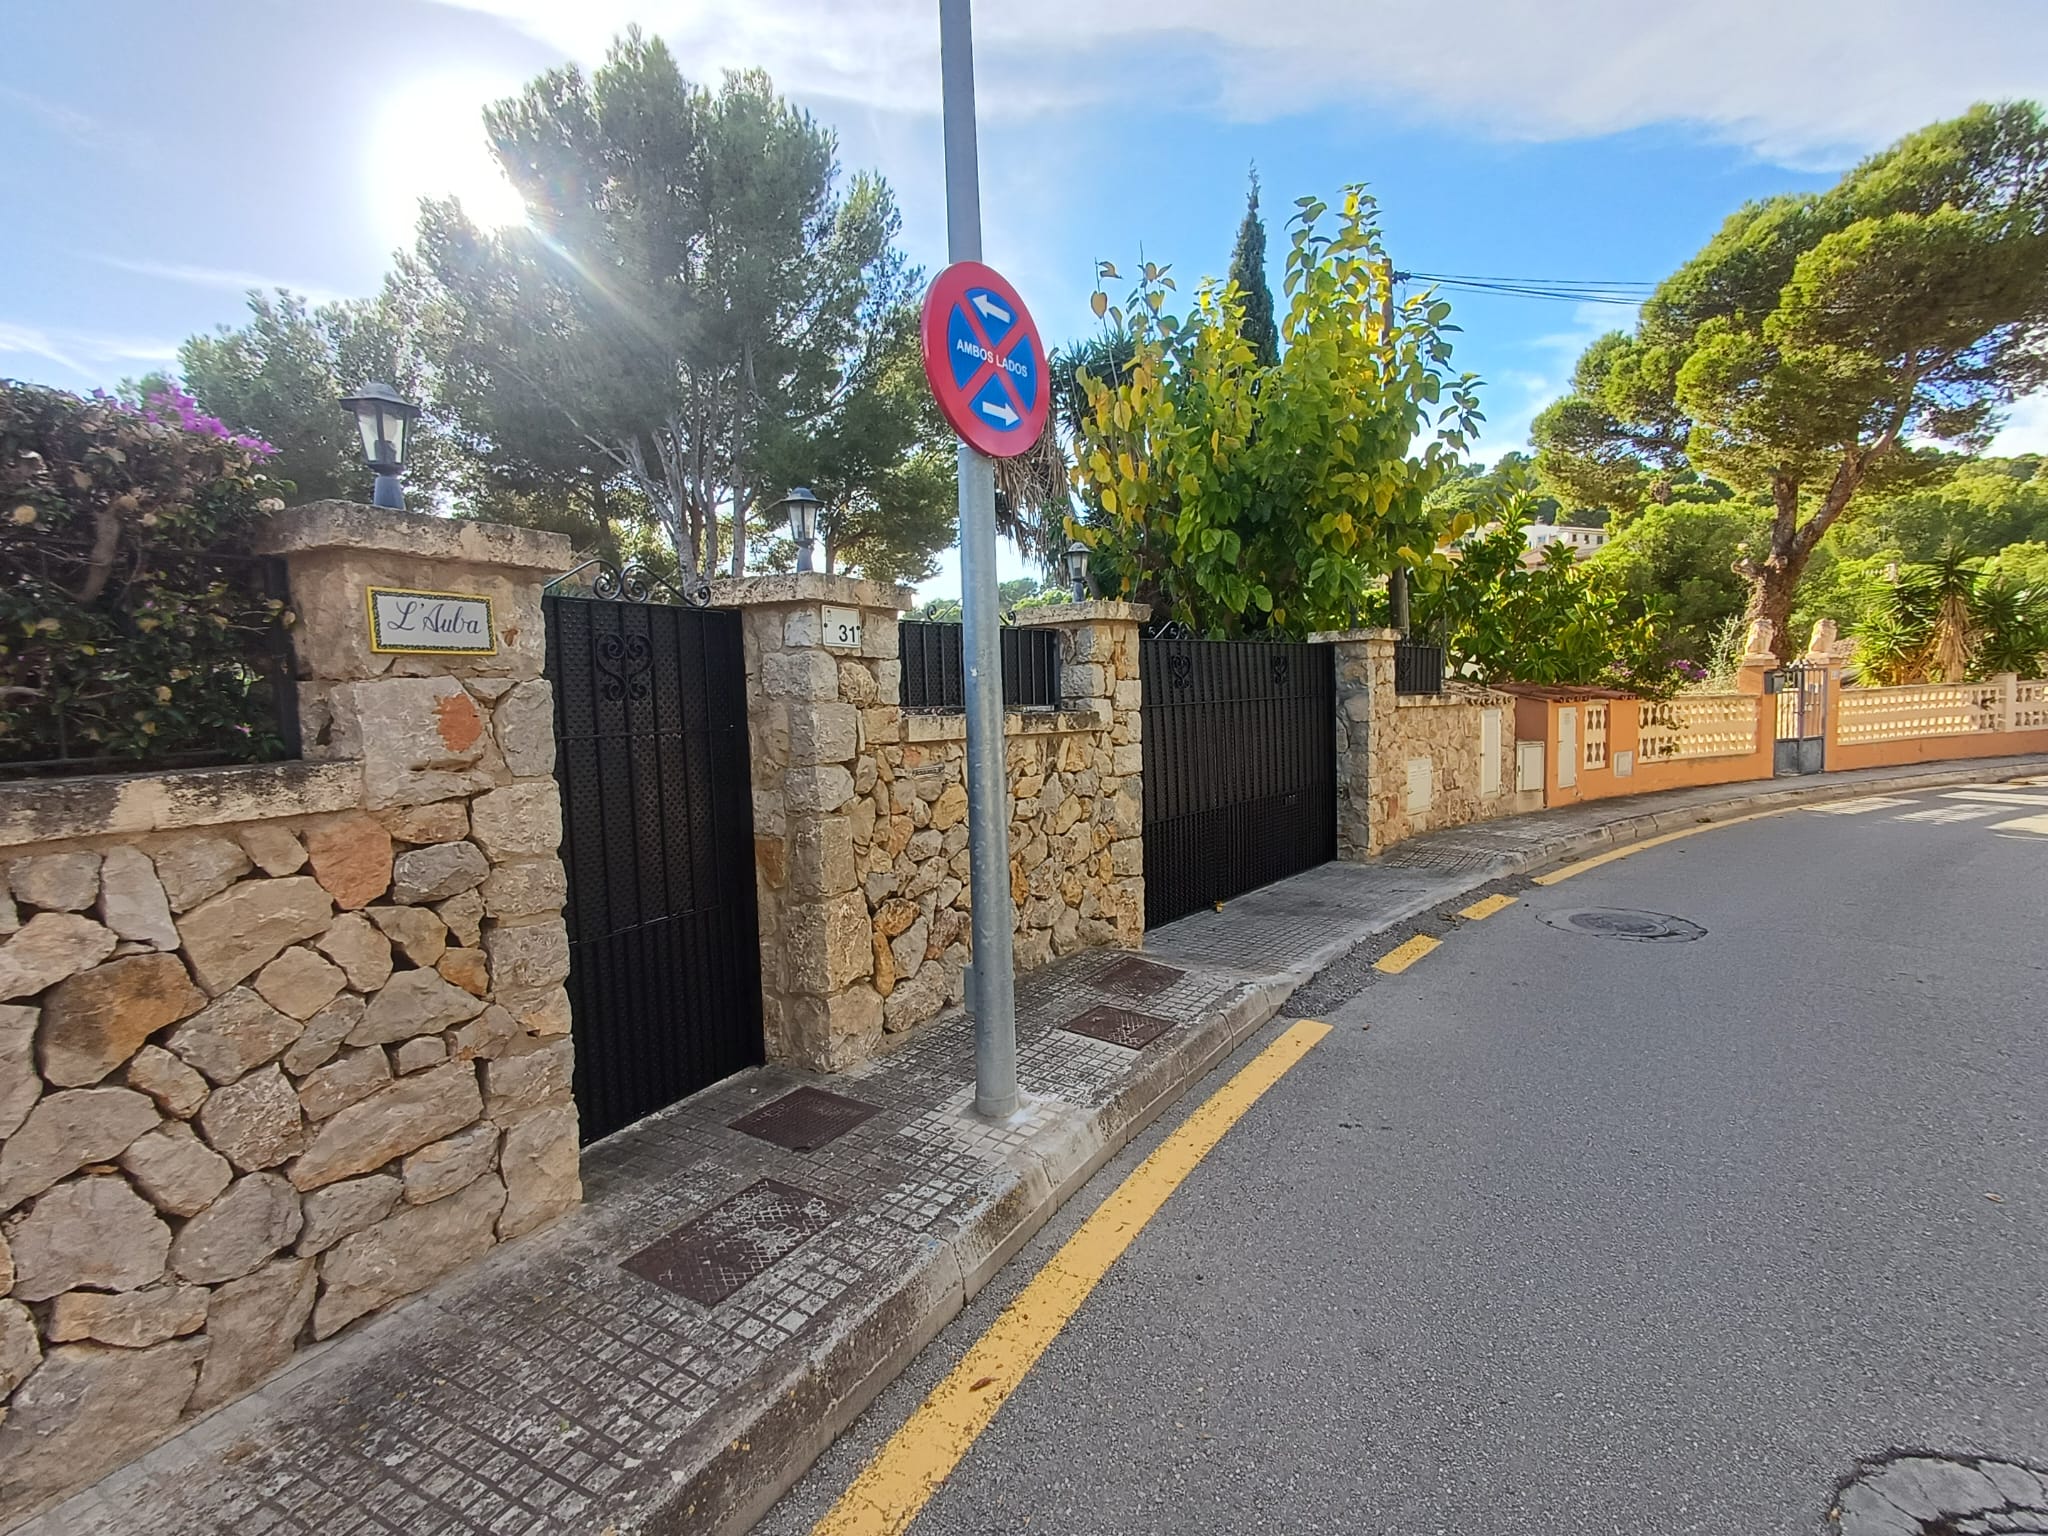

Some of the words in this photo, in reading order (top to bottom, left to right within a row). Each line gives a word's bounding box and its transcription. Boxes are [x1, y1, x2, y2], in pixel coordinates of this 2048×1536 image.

[956, 338, 994, 364] AMBOS
[996, 354, 1028, 378] LADOS
[387, 601, 481, 634] L'Auba
[839, 624, 856, 643] 31
